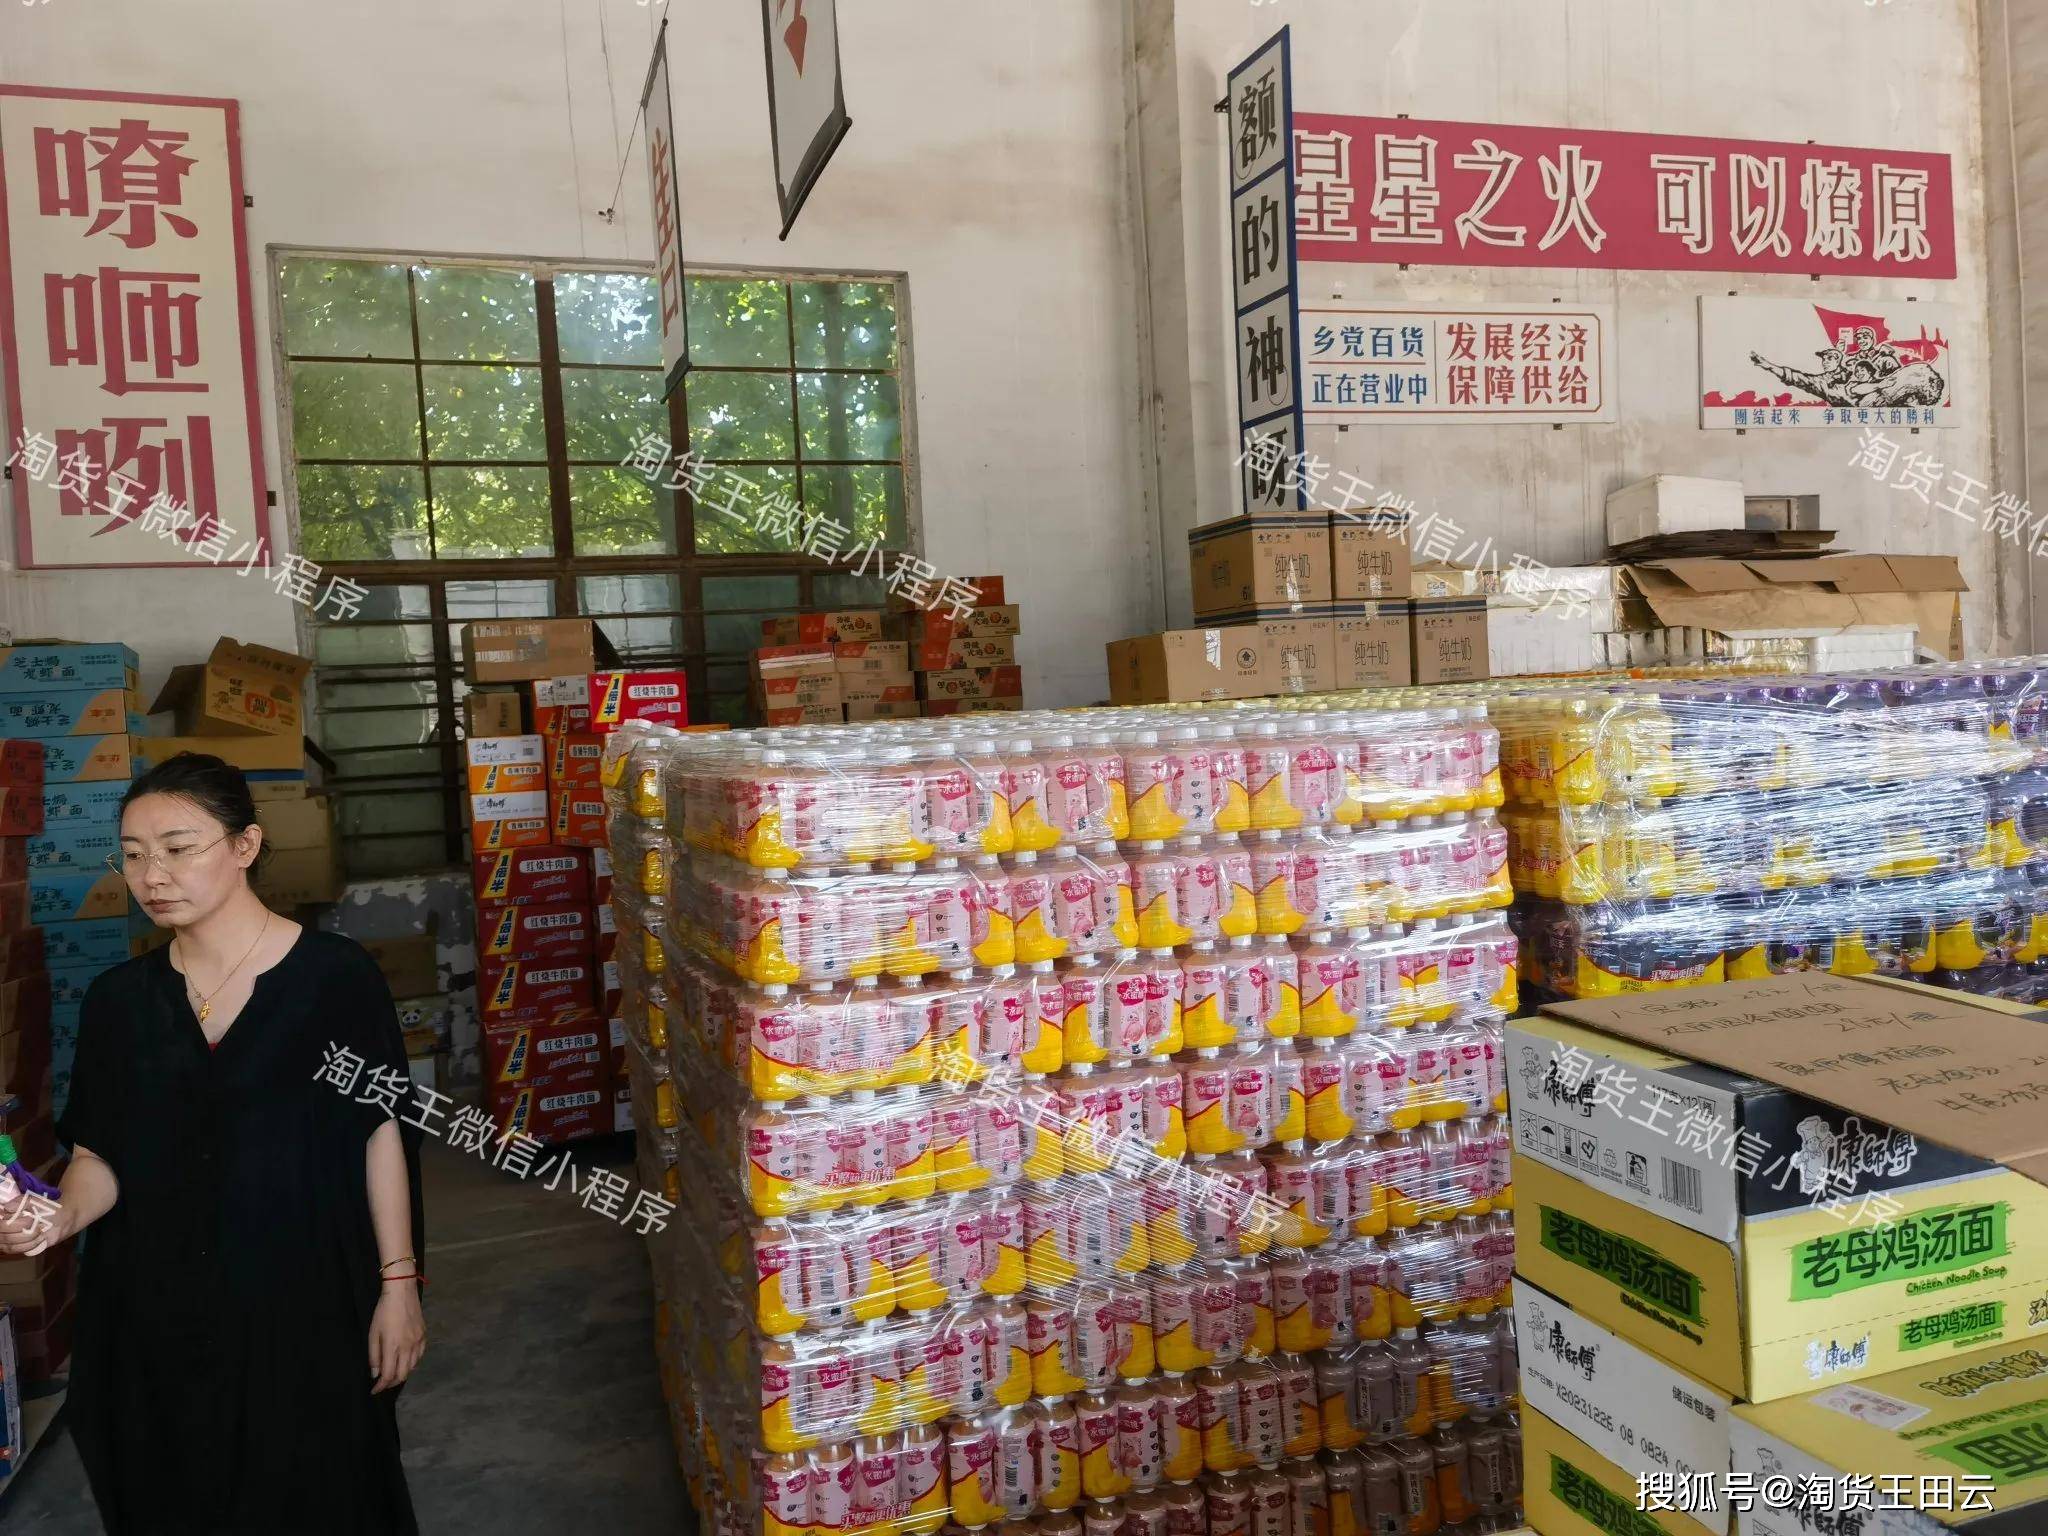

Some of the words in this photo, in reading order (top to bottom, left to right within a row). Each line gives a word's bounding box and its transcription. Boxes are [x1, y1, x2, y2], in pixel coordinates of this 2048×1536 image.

[1292, 129, 1607, 254] 星星之火
[1650, 153, 1932, 263] 可以燎原
[1310, 325, 1425, 358] 乡党百货
[1446, 321, 1589, 363] 发展经济
[1311, 373, 1428, 405] 正在营业中
[1446, 365, 1590, 405] 保障供给
[1274, 552, 1313, 580] 纯牛奶
[1357, 549, 1394, 577] 纯牛奶
[1280, 643, 1317, 671] 纯牛奶
[1353, 642, 1390, 667] 纯牛奶
[1438, 637, 1473, 663] 纯牛奶
[1550, 1208, 1693, 1315] 老母鸡汤面
[1802, 1205, 1996, 1288] 老母鸡汤面
[1906, 1278, 1943, 1294] Chicken
[1946, 1271, 1981, 1286] Noodle
[1982, 1265, 2007, 1280] Soup
[1904, 1301, 1996, 1344] 老母鸡汤面
[1549, 1320, 1597, 1382] 康師傅
[1672, 1385, 1717, 1423] 储运包装
